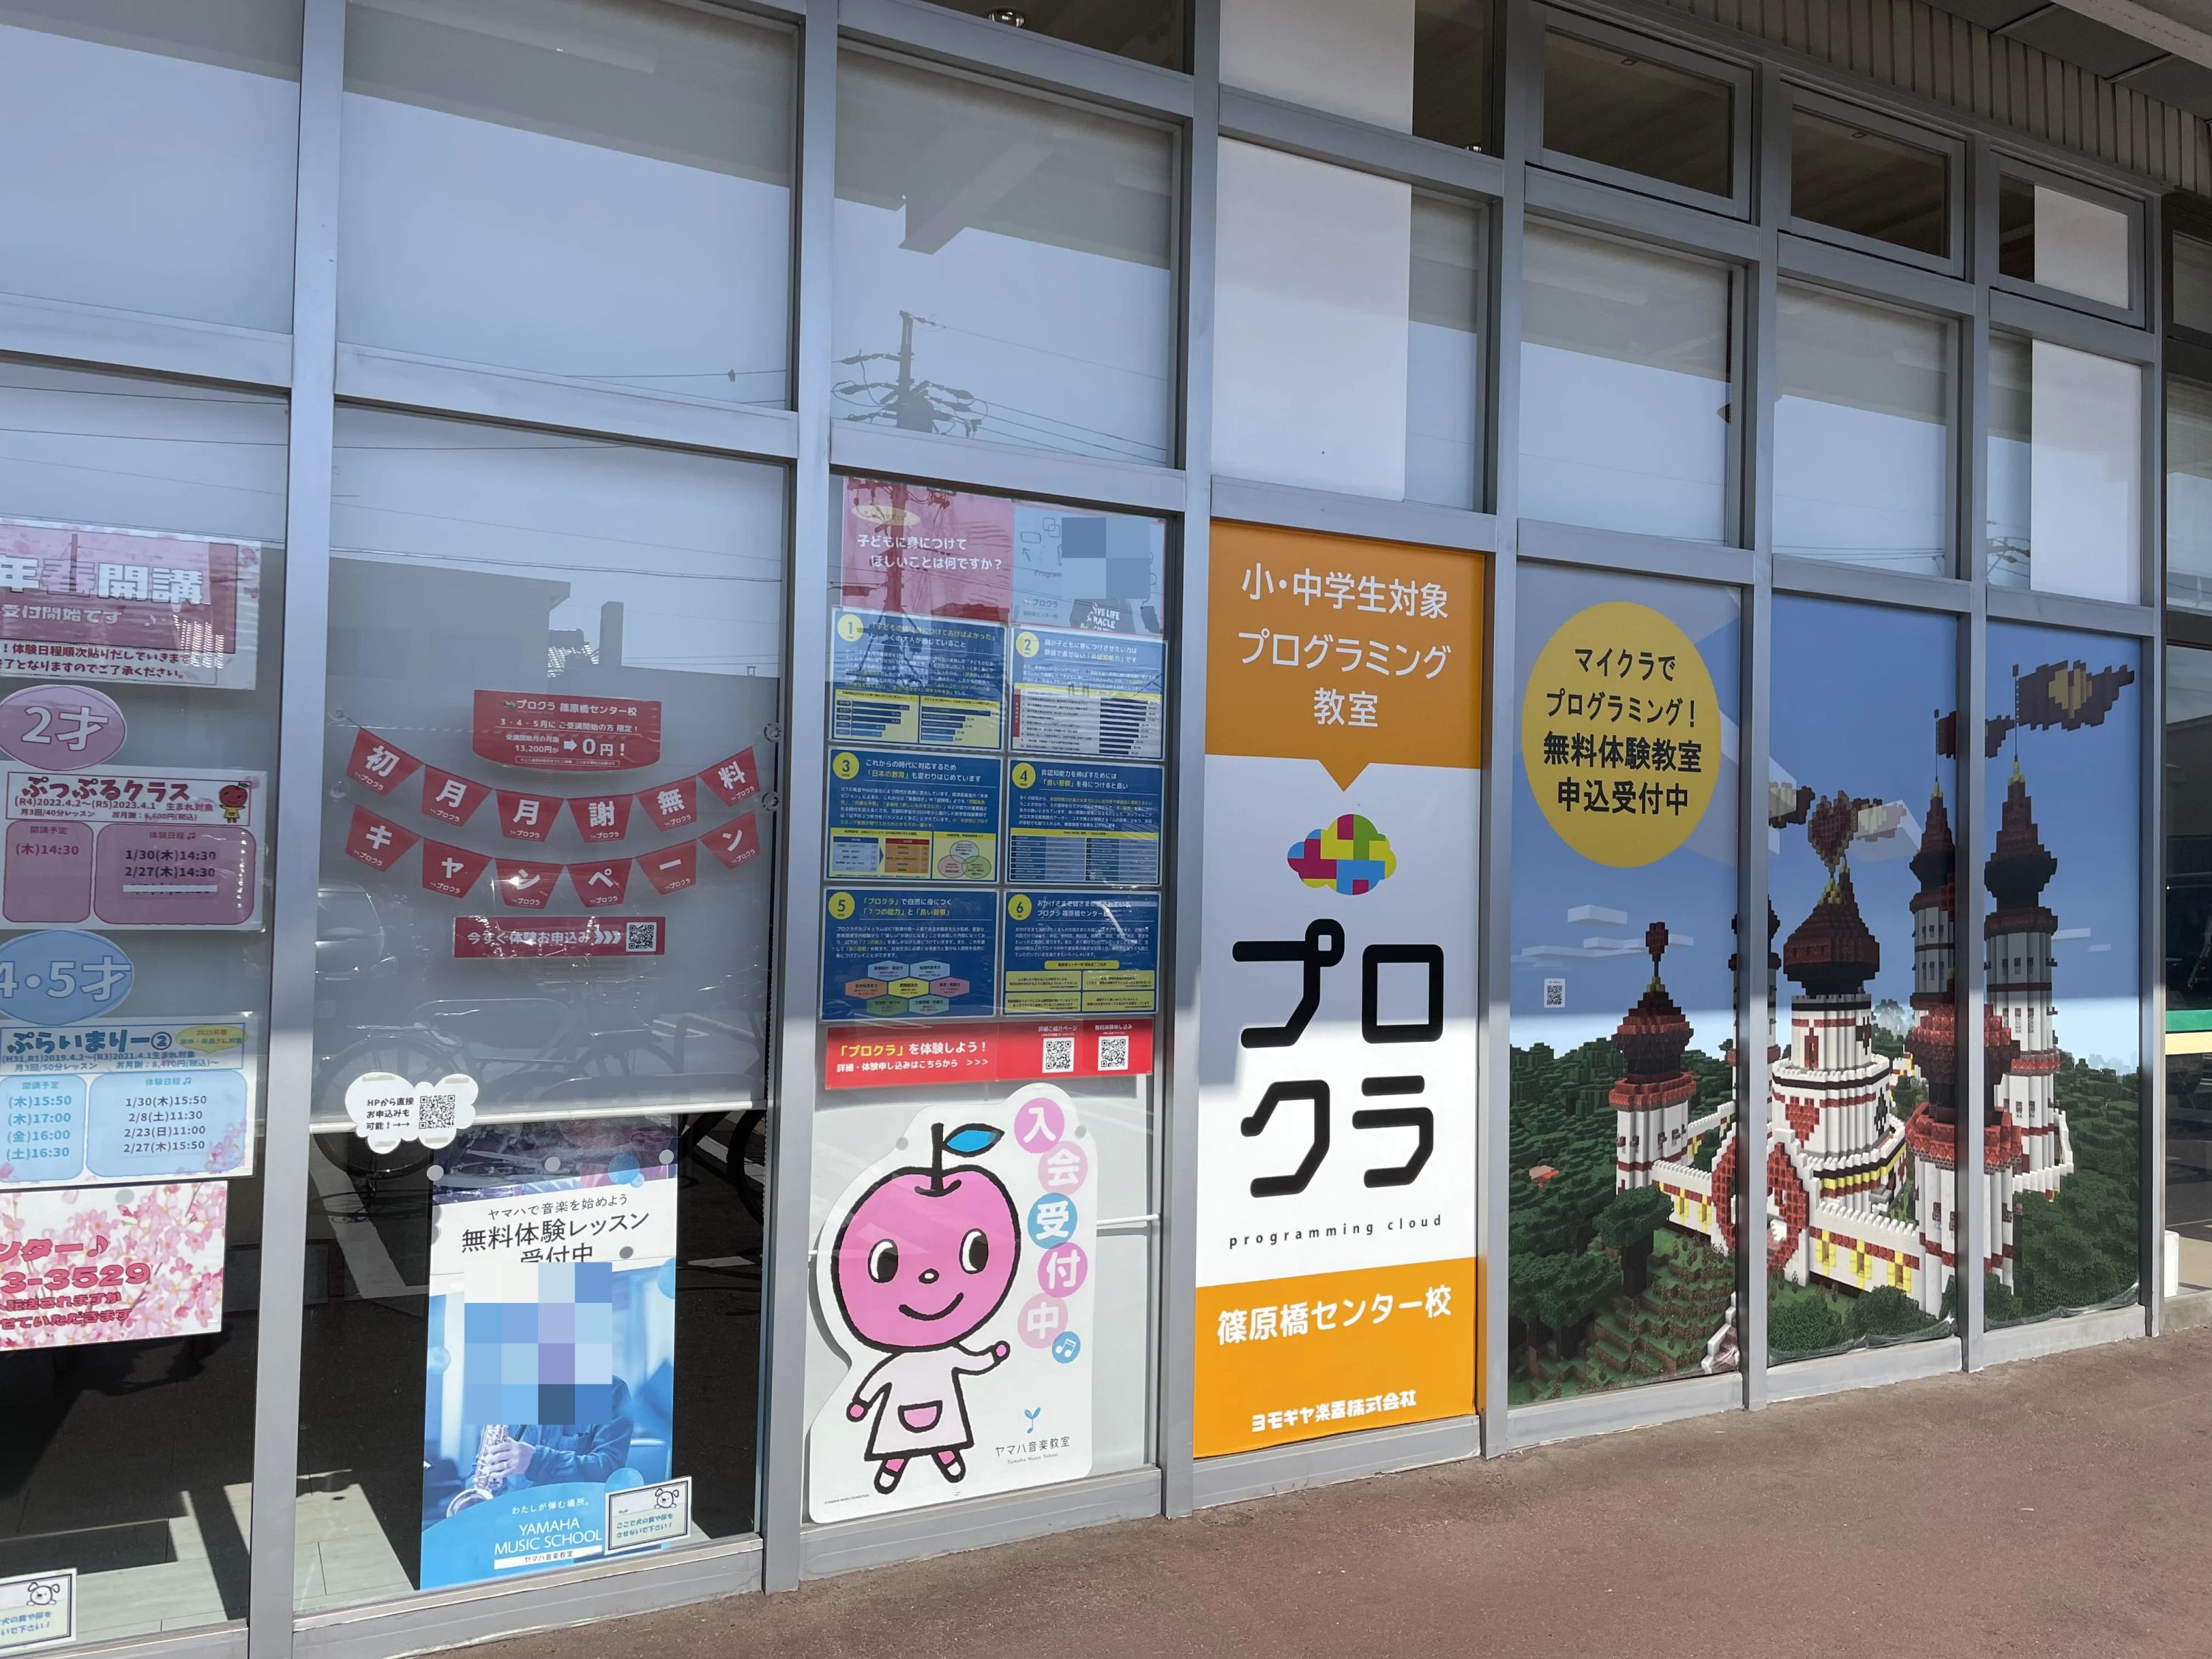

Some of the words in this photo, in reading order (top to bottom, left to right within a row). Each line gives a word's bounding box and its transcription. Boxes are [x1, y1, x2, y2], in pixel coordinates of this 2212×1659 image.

[858, 534, 967, 550] 子どもに身につけて
[871, 554, 1002, 570] ほしいことは何ですか？
[1242, 563, 1448, 619] 小・中学生対象
[1239, 628, 1451, 679] プログラミング
[0, 658, 183, 678] 了となりますのでご了承ください。
[1575, 647, 1675, 681] マイクラで
[517, 700, 555, 711] プロクラ
[1314, 687, 1378, 727] 教室
[1546, 687, 1694, 728] プログラミング！
[21, 706, 108, 751] 2才
[1543, 731, 1702, 773] 無料体験教室
[842, 760, 850, 772] 3
[1020, 771, 1028, 782] 4
[22, 776, 189, 803] ぷっぷるクラス
[1558, 776, 1688, 815] 申込受付中
[15, 845, 79, 856] (木)14:30
[125, 849, 217, 861] 1/30(木)14:30
[124, 866, 216, 877] 2/27(木)14:30
[838, 900, 846, 912] 5
[1016, 902, 1023, 914] 6
[9, 1096, 72, 1107] (木)15:50
[125, 1095, 207, 1107] 1/30(木)15:50
[367, 1097, 414, 1107] HPから直接
[7, 1113, 72, 1125] (木)17:00
[128, 1110, 203, 1123] 2/8(土)11:30
[366, 1109, 410, 1119] お申込みも
[7, 1130, 71, 1144] (金)16:00
[124, 1125, 206, 1138] 2/23(日)11:00
[6, 1147, 70, 1161] (土)16:30
[123, 1141, 206, 1153] 2/27(木)15:50
[488, 1194, 628, 1220] ヤマハで音楽を始めよう
[462, 1212, 650, 1253] 無料体験レッスン
[1229, 1222, 1374, 1249] programming
[1388, 1214, 1441, 1229] cloud
[1217, 1284, 1452, 1346] 篠原橋センター校
[1251, 1390, 1416, 1433] ヨモギヤ楽器株式会社
[995, 1436, 1070, 1457] ヤマハ音楽教室
[519, 1517, 580, 1536] YAMAHA
[495, 1537, 540, 1556] MUSIC
[544, 1529, 602, 1548] SCHOOL
[524, 1551, 574, 1563] ヤマハ音楽教室
